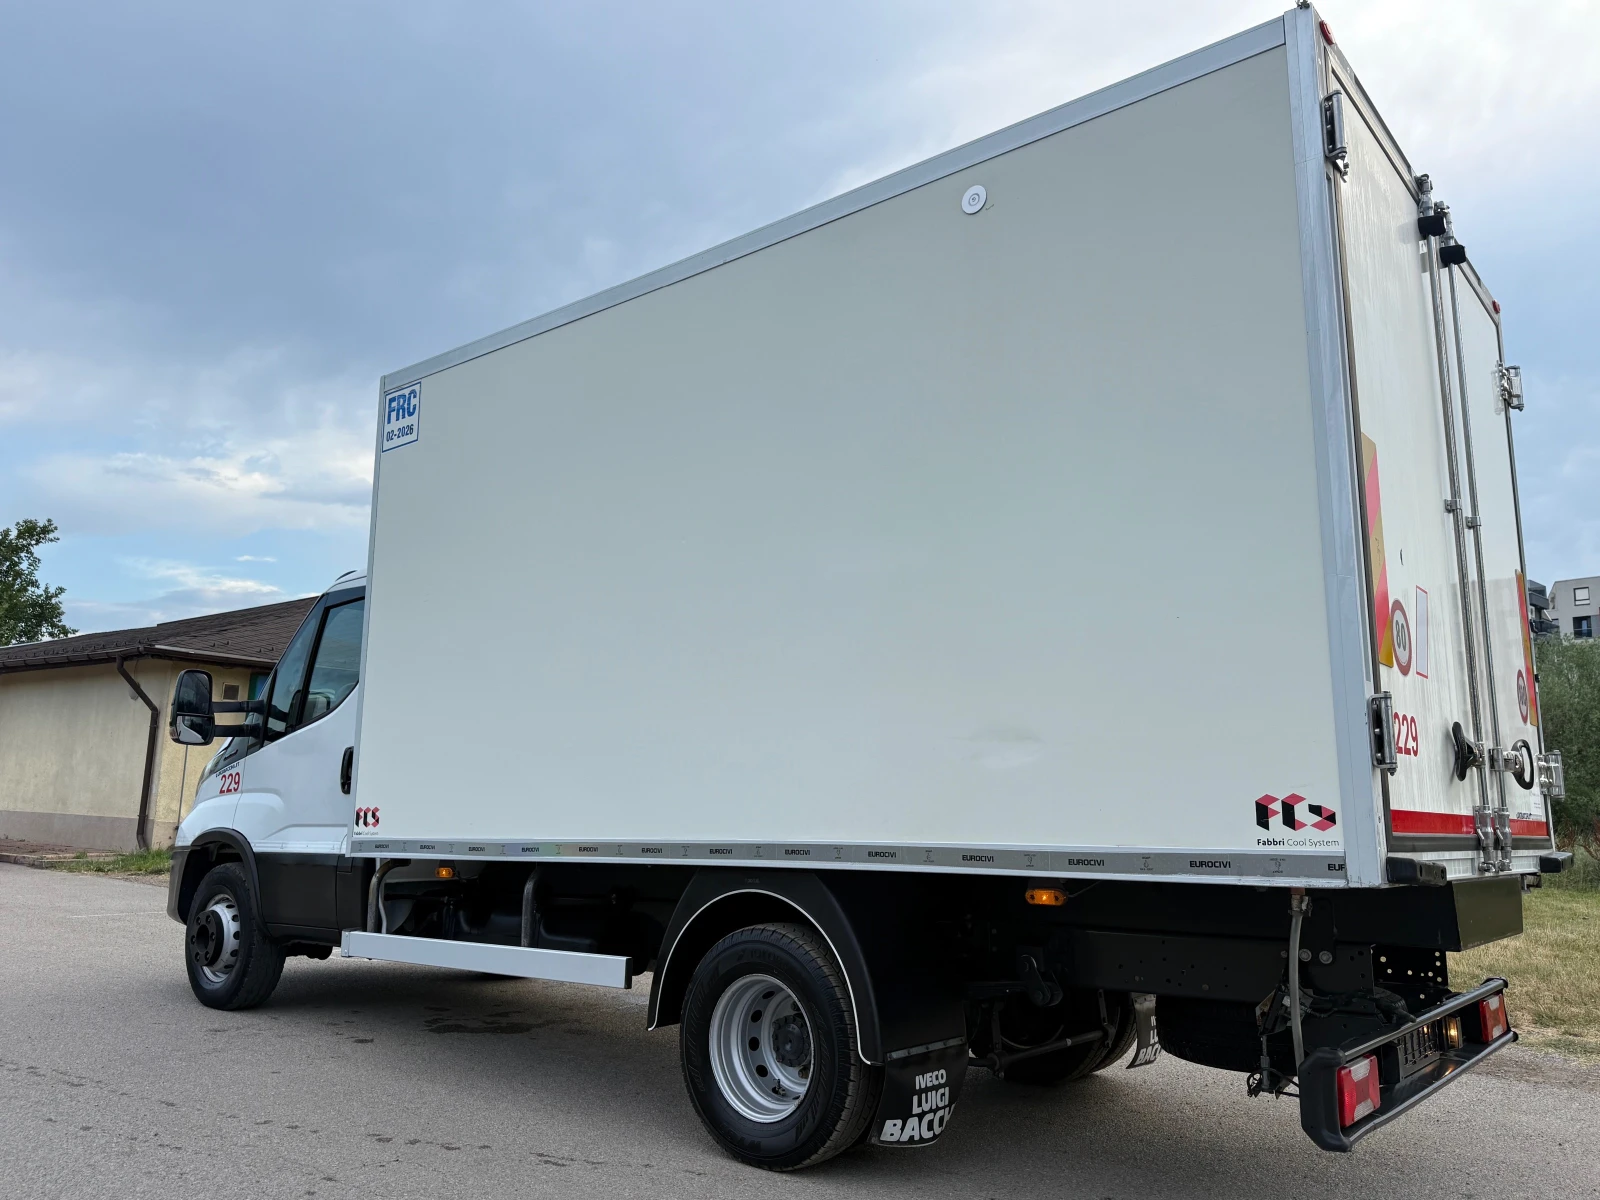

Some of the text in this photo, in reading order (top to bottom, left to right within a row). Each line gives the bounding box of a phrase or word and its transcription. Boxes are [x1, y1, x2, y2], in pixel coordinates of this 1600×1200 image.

[387, 388, 418, 425] FRC
[386, 424, 414, 442] 02-2026
[1395, 619, 1407, 652] 80
[1393, 711, 1419, 757] 229
[219, 771, 241, 794] 229
[355, 806, 380, 828] FCS
[1255, 793, 1337, 832] FCS
[1257, 838, 1340, 848] Fabbri Cool System
[961, 854, 995, 863] EUROCIVI
[1068, 859, 1105, 867] EUROCIVI
[1189, 860, 1231, 869] EUROCIVI
[915, 1068, 947, 1090] IVECO
[912, 1086, 950, 1115] LUIGI
